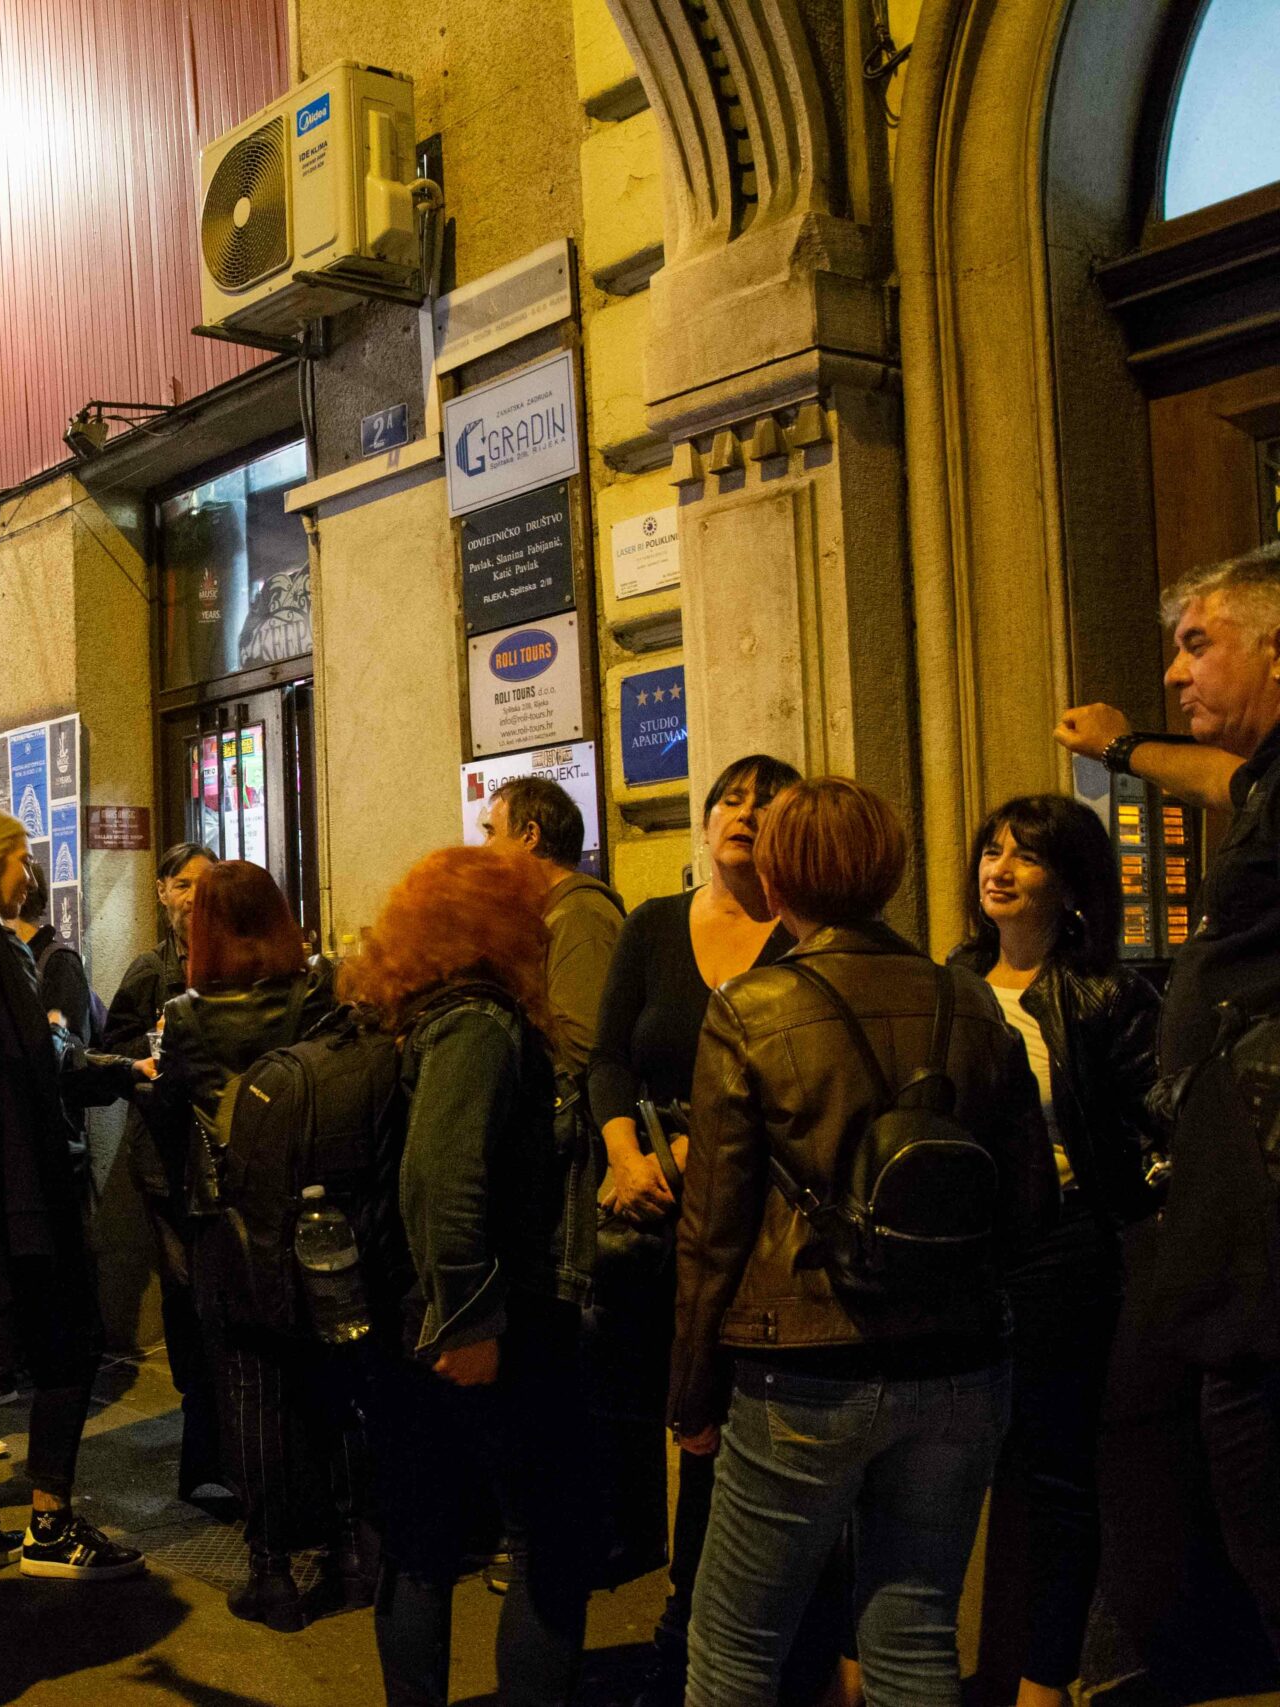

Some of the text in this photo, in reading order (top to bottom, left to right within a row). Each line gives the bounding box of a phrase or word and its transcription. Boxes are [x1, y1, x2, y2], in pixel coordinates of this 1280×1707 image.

[299, 107, 327, 131] Midea
[496, 390, 553, 418] ZANATSKA ZADRUGA
[488, 403, 566, 461] GRADIN
[532, 437, 566, 454] RIJEKA
[467, 512, 563, 551] ODVJETNIČKO DRUŠTVO
[496, 550, 524, 565] Slanina
[515, 559, 539, 574] Pavlak
[510, 583, 537, 596] Splitska
[495, 642, 552, 669] ROLI TOURS
[494, 691, 510, 705] ROLI
[512, 686, 536, 701] TOURS
[640, 715, 679, 733] STUDIO
[487, 773, 525, 792] GLO
